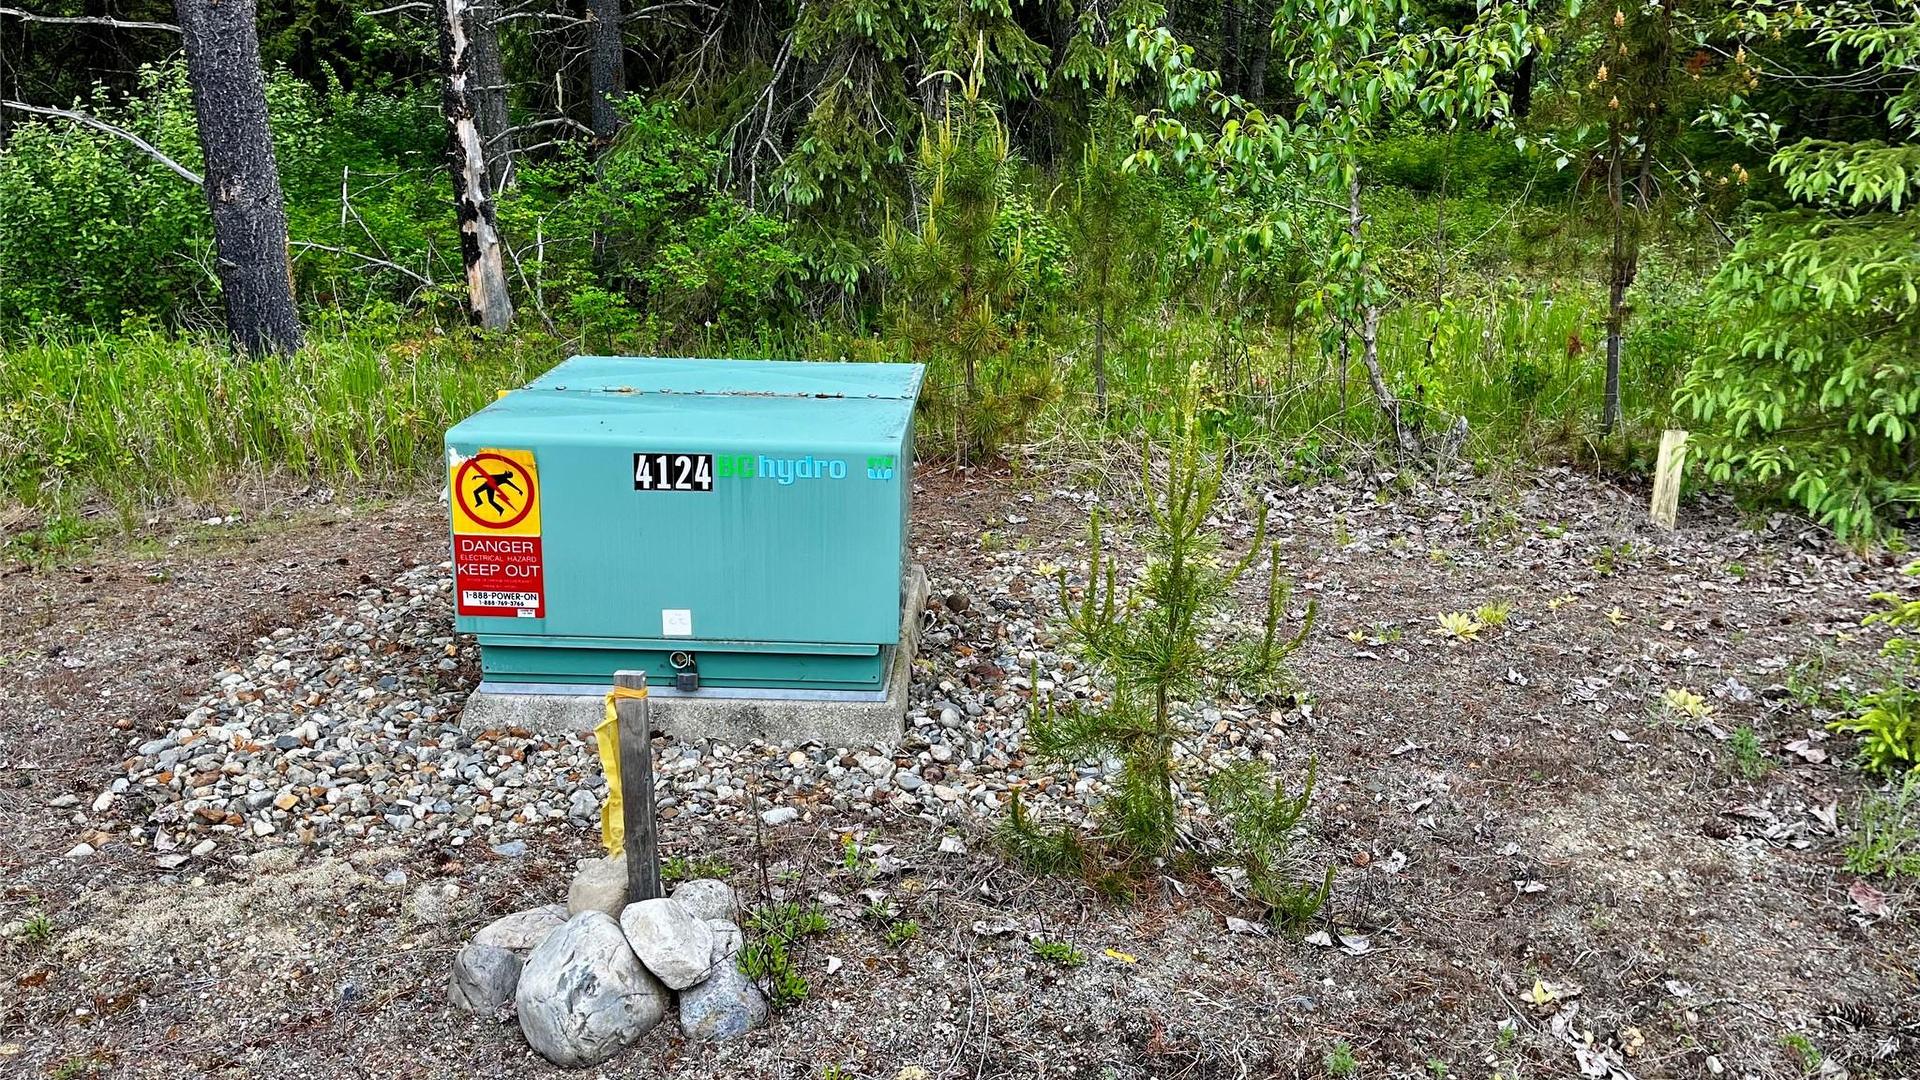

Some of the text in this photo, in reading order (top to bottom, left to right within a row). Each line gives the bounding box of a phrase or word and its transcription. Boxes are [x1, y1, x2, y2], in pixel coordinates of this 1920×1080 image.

[635, 454, 712, 490] 4124
[717, 454, 847, 485] BC hydro
[462, 540, 533, 553] DANGER
[460, 554, 537, 563] ELECTRICAL HAZARD
[457, 563, 540, 577] KEEP OUT
[465, 592, 537, 601] 1-888-POWER-ON
